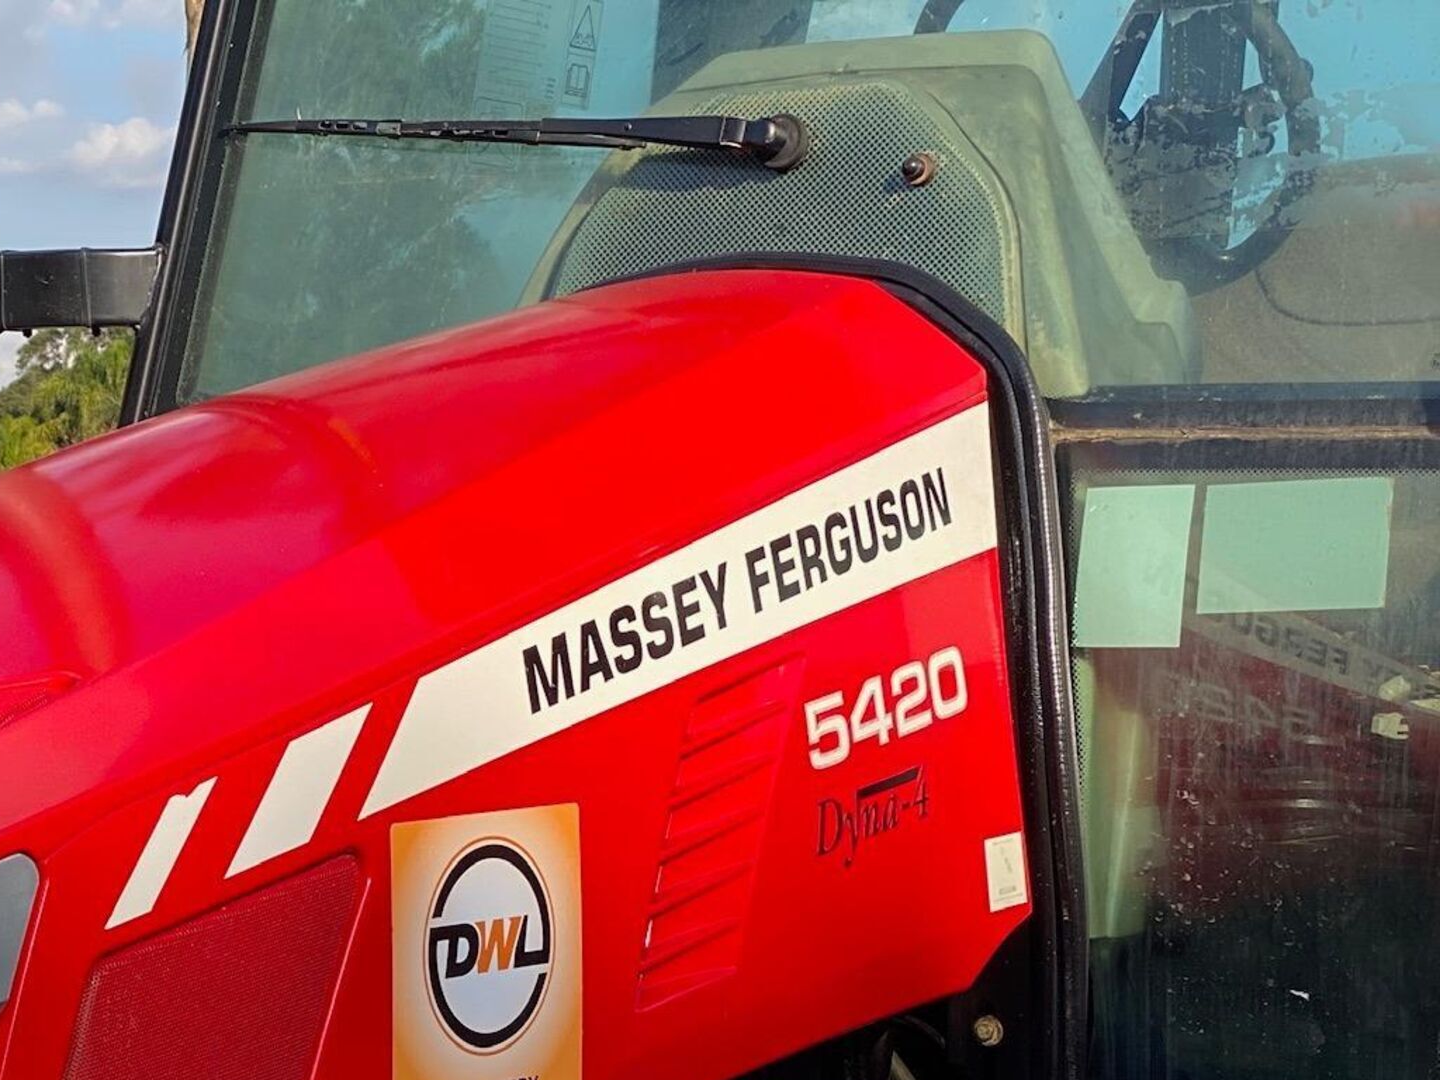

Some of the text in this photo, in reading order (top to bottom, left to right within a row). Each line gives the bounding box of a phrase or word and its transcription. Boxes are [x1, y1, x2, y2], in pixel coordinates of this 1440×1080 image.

[522, 467, 953, 714] MASSEY FERGUSON
[803, 645, 968, 770] 5420
[816, 764, 930, 868] Dyna-4
[429, 914, 550, 979] DWL
